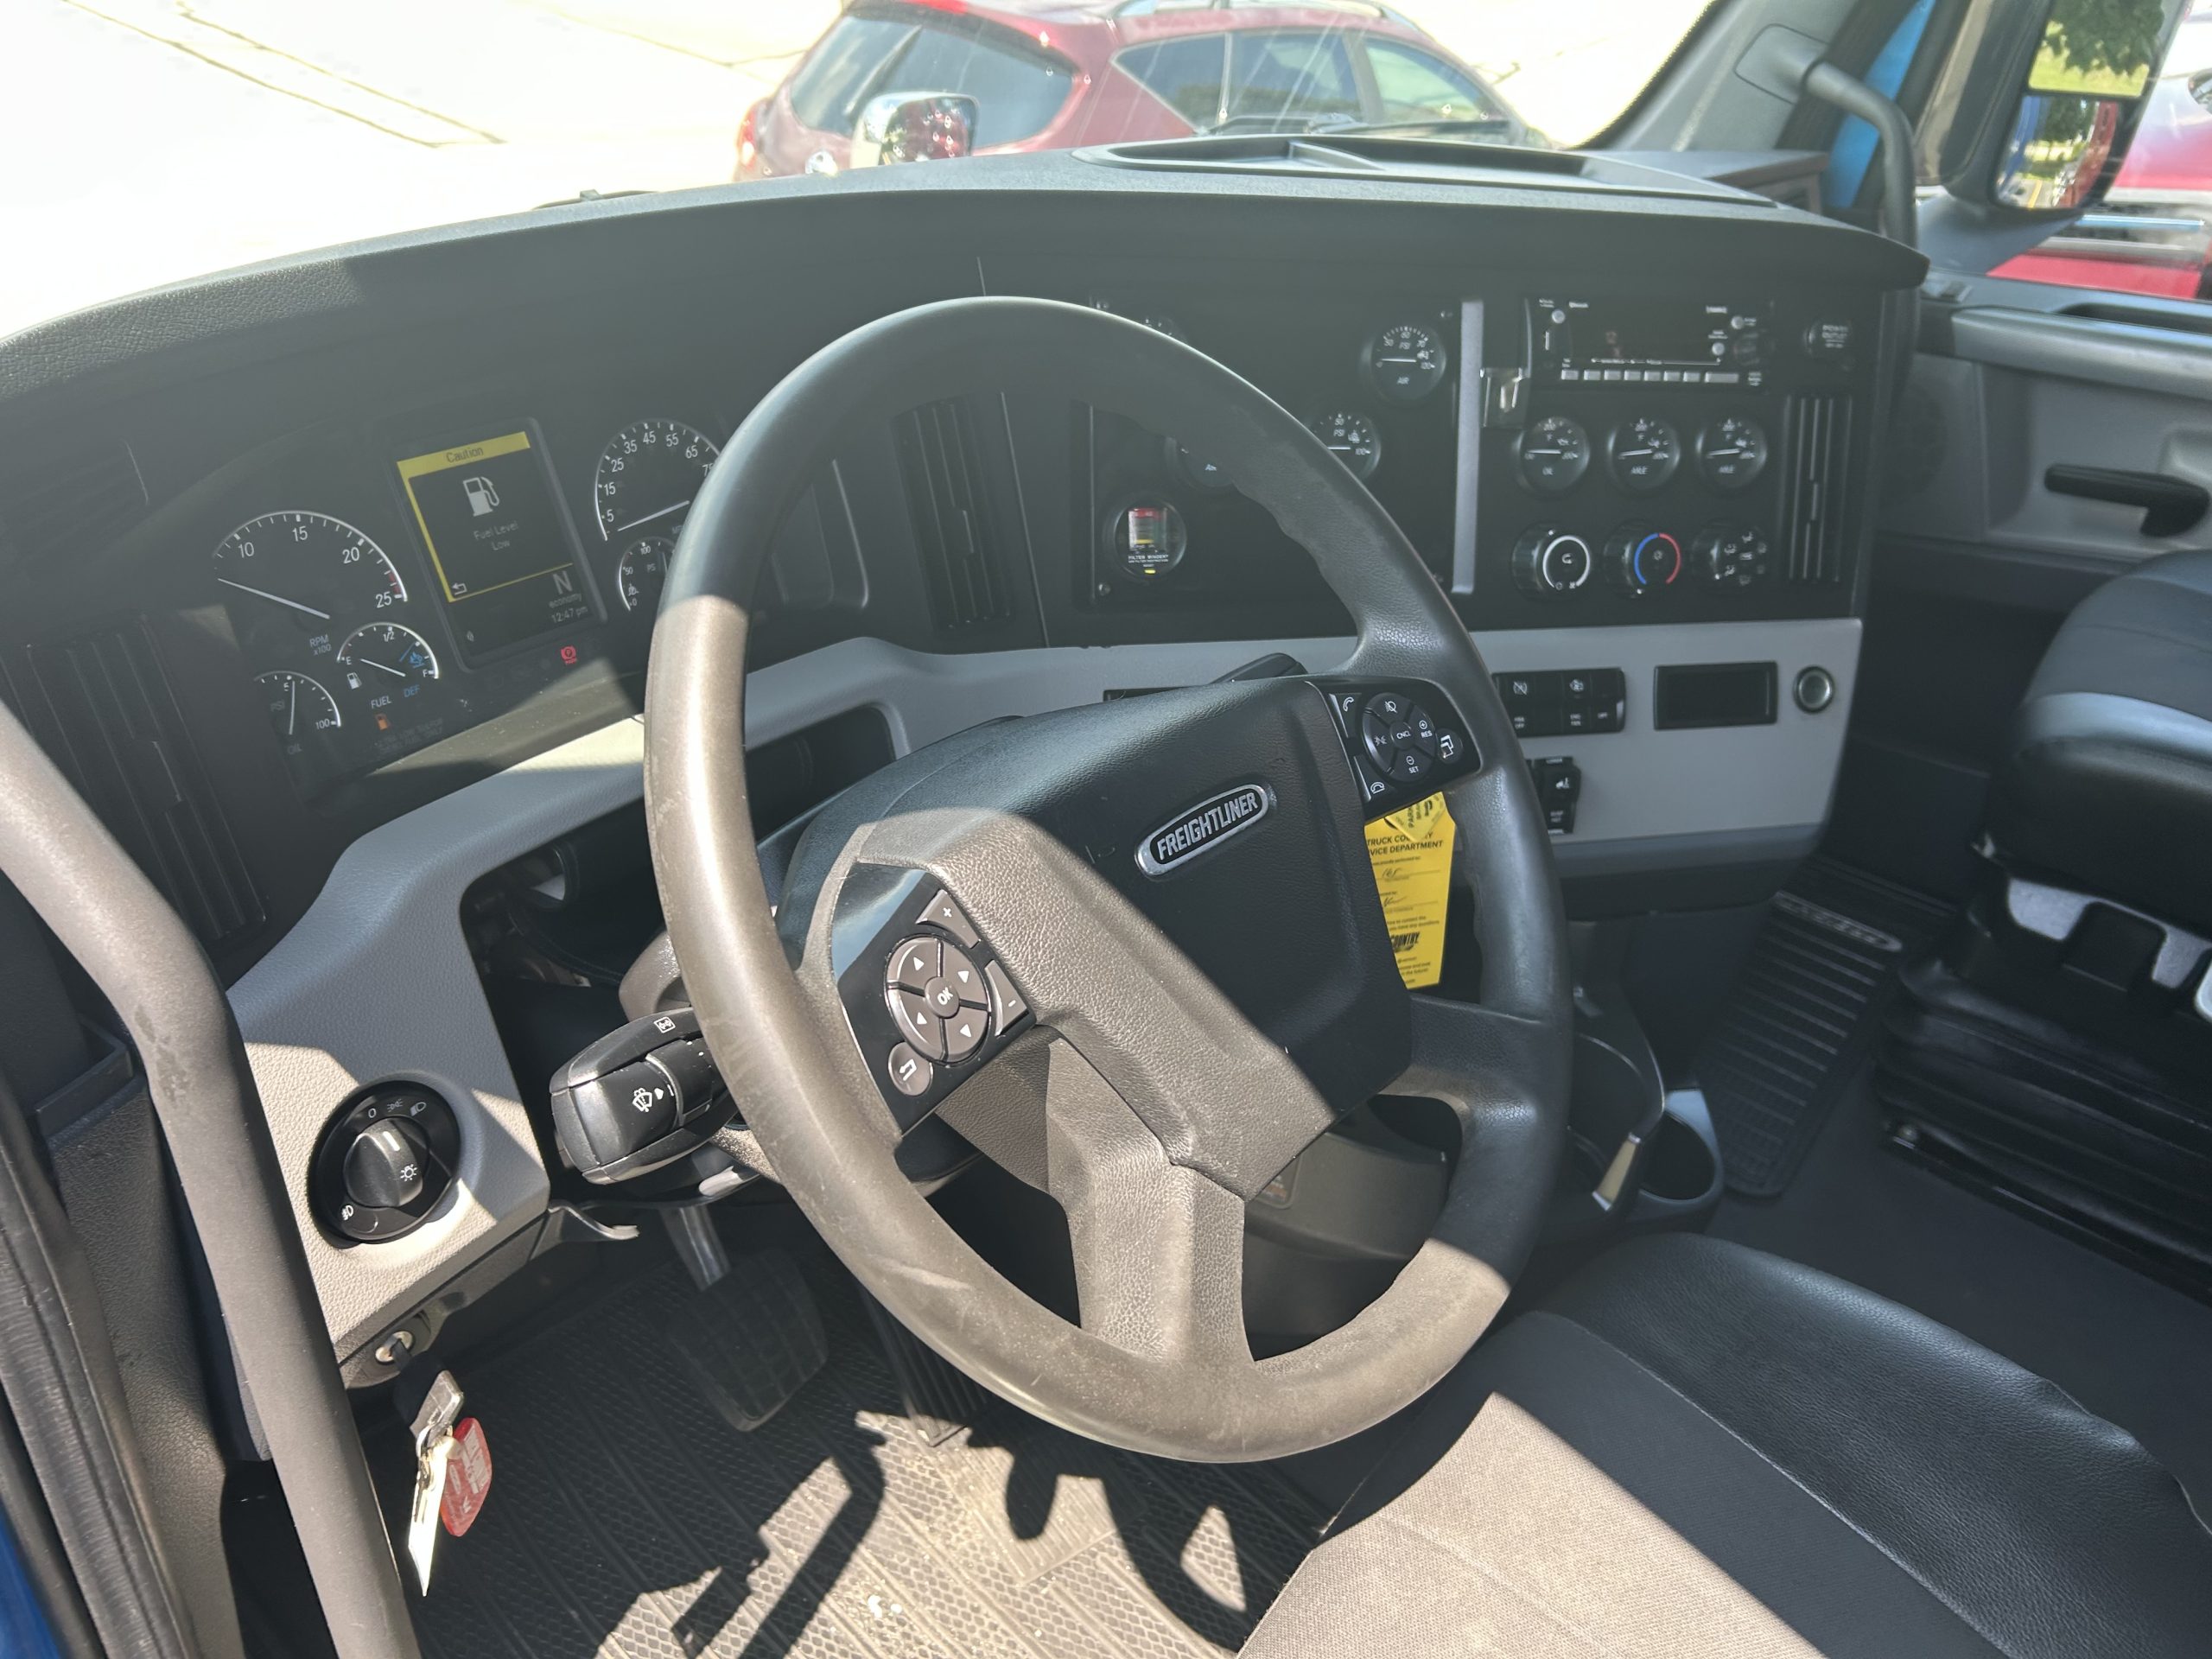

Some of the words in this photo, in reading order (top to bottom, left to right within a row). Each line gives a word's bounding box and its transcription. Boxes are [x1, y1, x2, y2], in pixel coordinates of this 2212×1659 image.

[642, 430, 657, 444] 45
[665, 433, 679, 448] 55
[623, 439, 638, 454] 35
[684, 444, 698, 460] 65
[446, 446, 485, 464] Caution
[610, 458, 625, 474] 25
[604, 482, 617, 497] 15
[607, 509, 614, 523] 5
[291, 525, 308, 543] 15
[474, 527, 493, 541] Fuel
[494, 520, 519, 537] Level
[238, 542, 255, 559] 10
[491, 538, 511, 551] Low
[640, 544, 652, 556] 100
[341, 546, 360, 564] 20
[624, 565, 633, 576] 50
[553, 570, 573, 594] N
[375, 591, 393, 608] 25
[309, 634, 329, 648] RPM
[382, 632, 396, 643] 1/2
[313, 644, 332, 656] x100
[346, 656, 353, 666] E
[404, 684, 420, 698] DEF
[370, 696, 392, 709] FUEL
[315, 718, 331, 730] 100
[1421, 729, 1433, 739] RES
[1408, 766, 1420, 774] SET
[1155, 791, 1259, 861] FREIGHTLINER
[1367, 836, 1393, 846] TRUCK
[1389, 840, 1444, 853] DEPARTMENT
[937, 986, 955, 1006] OK
